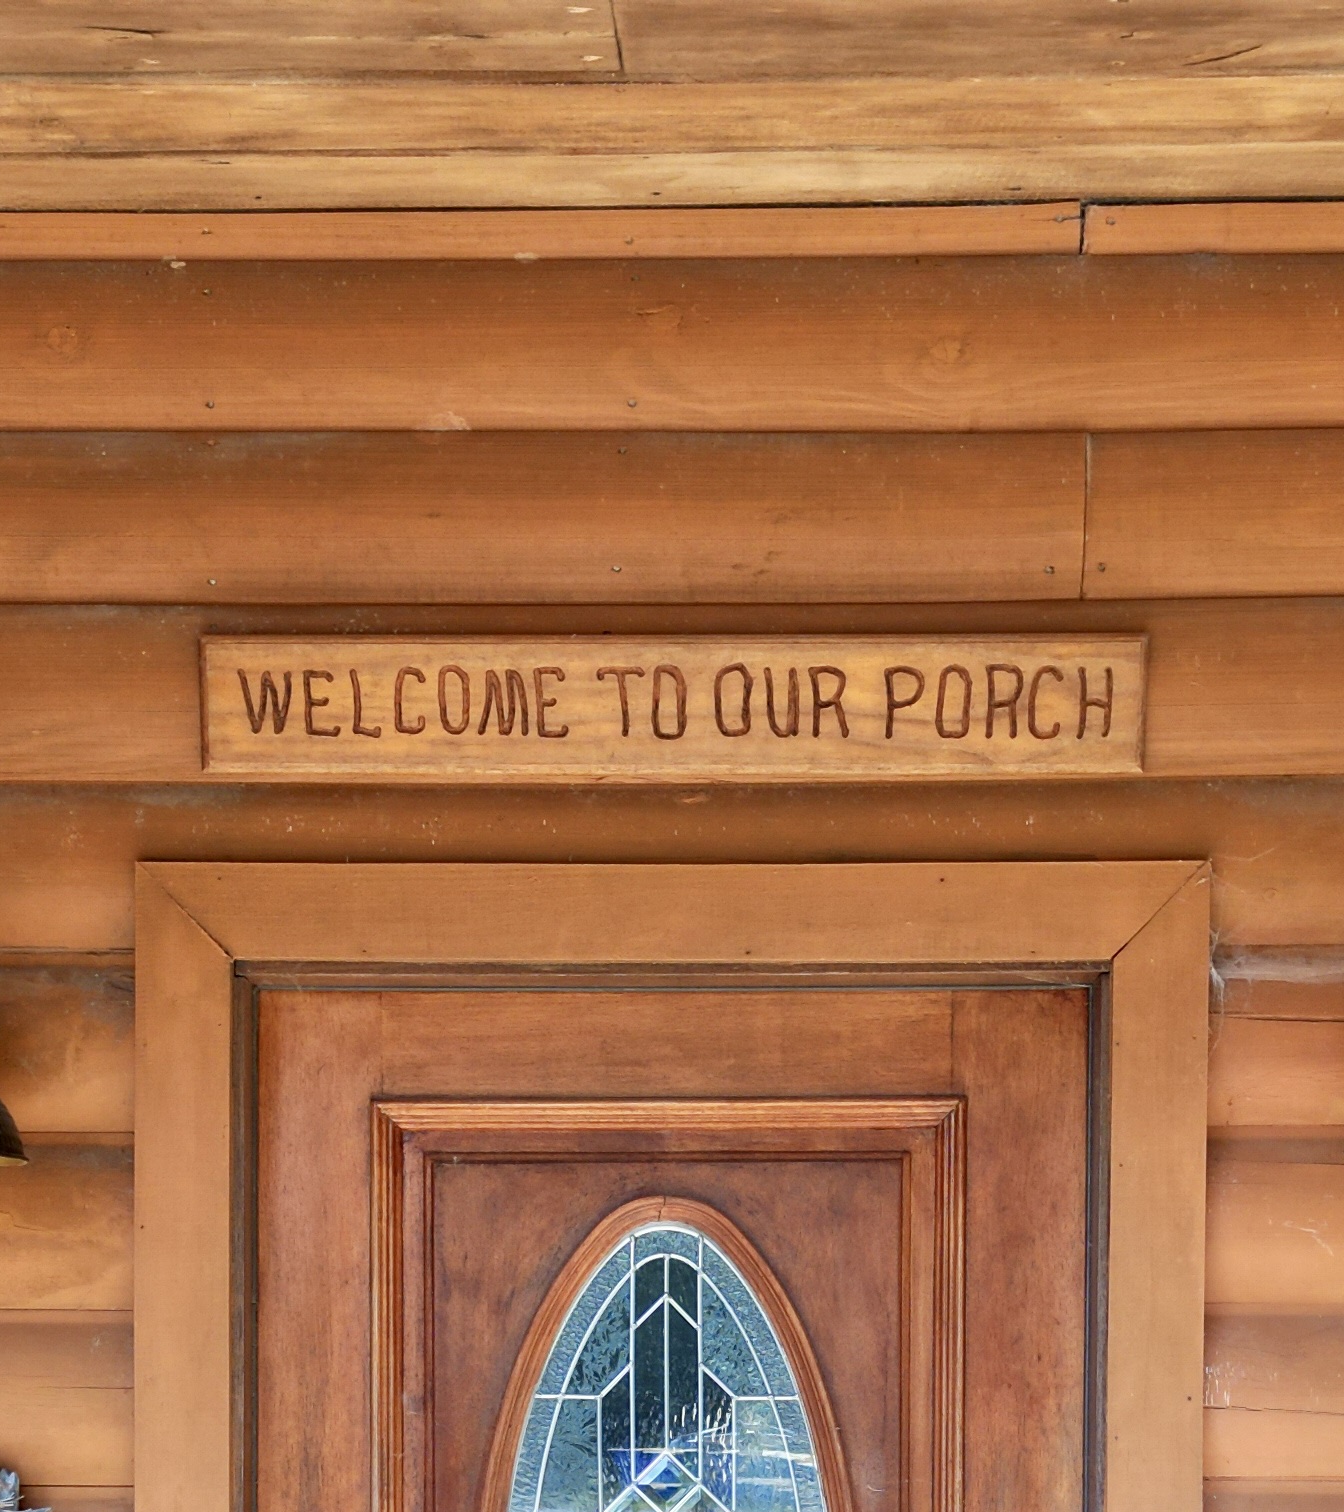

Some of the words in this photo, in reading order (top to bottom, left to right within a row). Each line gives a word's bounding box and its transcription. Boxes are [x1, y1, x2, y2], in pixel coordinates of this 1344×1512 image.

[238, 665, 570, 739] WELCOME
[596, 664, 688, 740] TO
[713, 662, 850, 739] OUR
[883, 663, 1113, 740] PORCH
